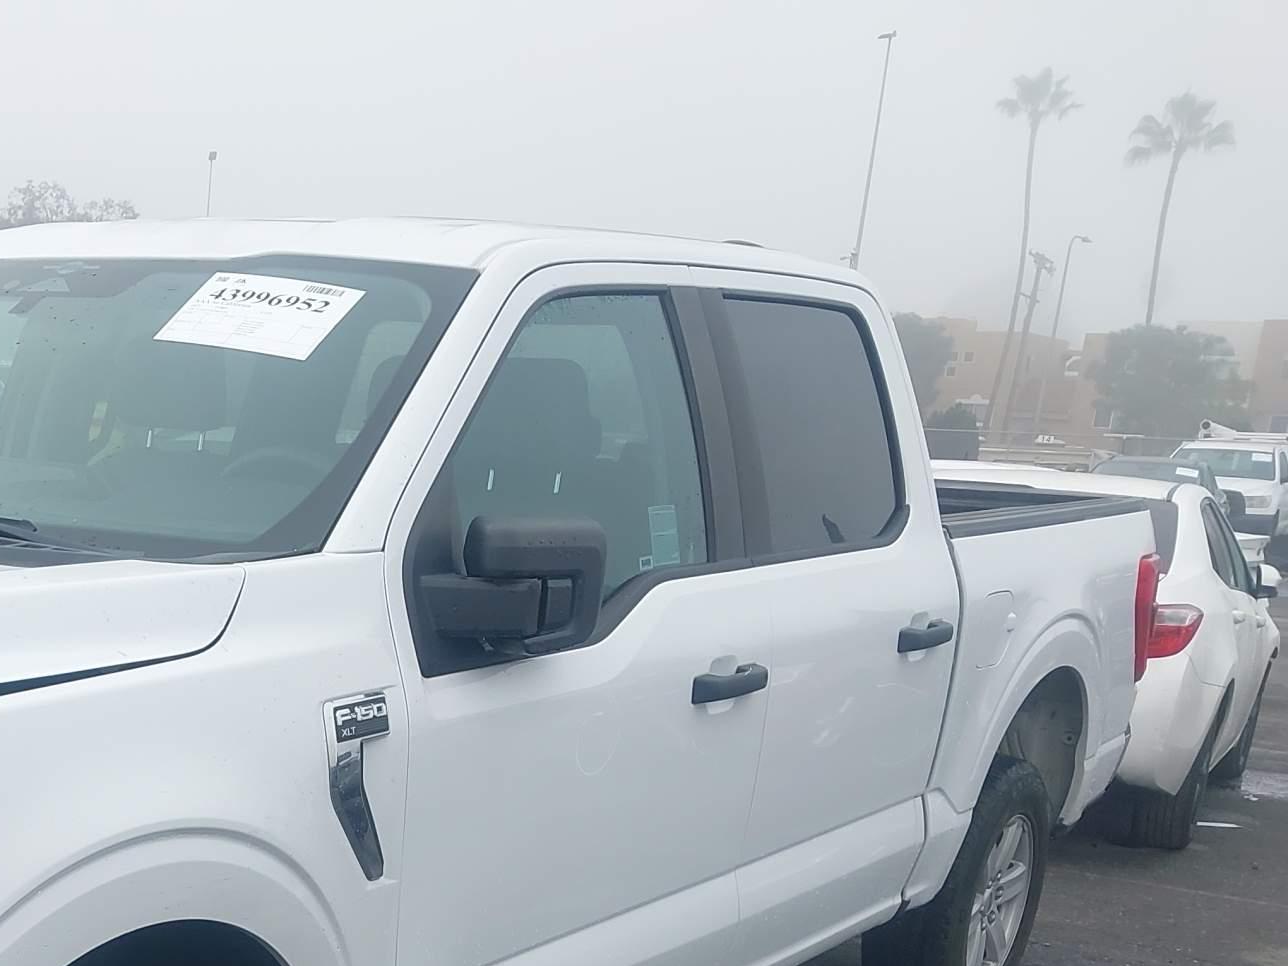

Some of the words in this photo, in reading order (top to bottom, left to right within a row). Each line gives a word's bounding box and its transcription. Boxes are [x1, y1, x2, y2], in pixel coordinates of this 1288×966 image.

[209, 287, 331, 313] 43996952
[336, 703, 387, 726] F-150
[340, 726, 357, 738] XLT
